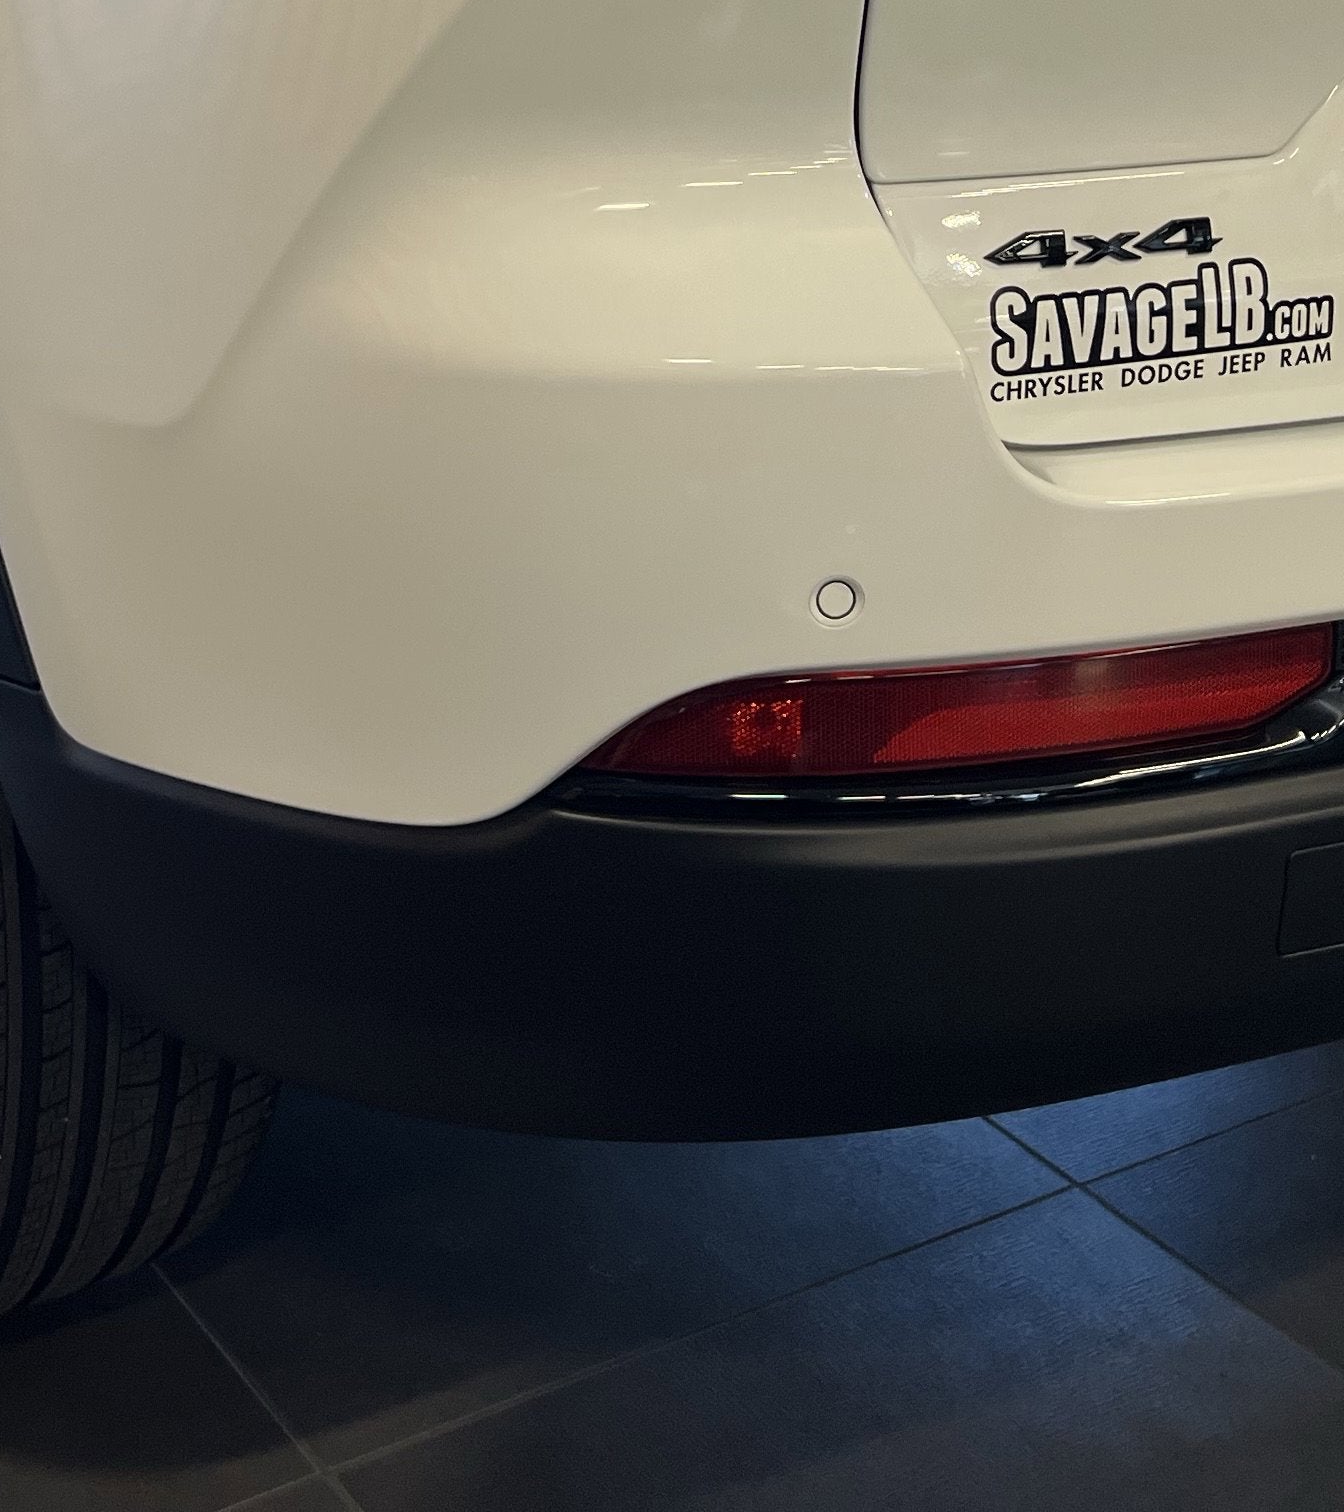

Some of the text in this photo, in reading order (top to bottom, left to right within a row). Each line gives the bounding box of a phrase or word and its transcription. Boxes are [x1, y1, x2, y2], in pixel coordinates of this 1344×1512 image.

[983, 216, 1224, 269] 4x4
[990, 258, 1335, 376] SAVAGELB.COM
[990, 342, 1333, 402] CHRYSLER DODGE JEEP RAM
